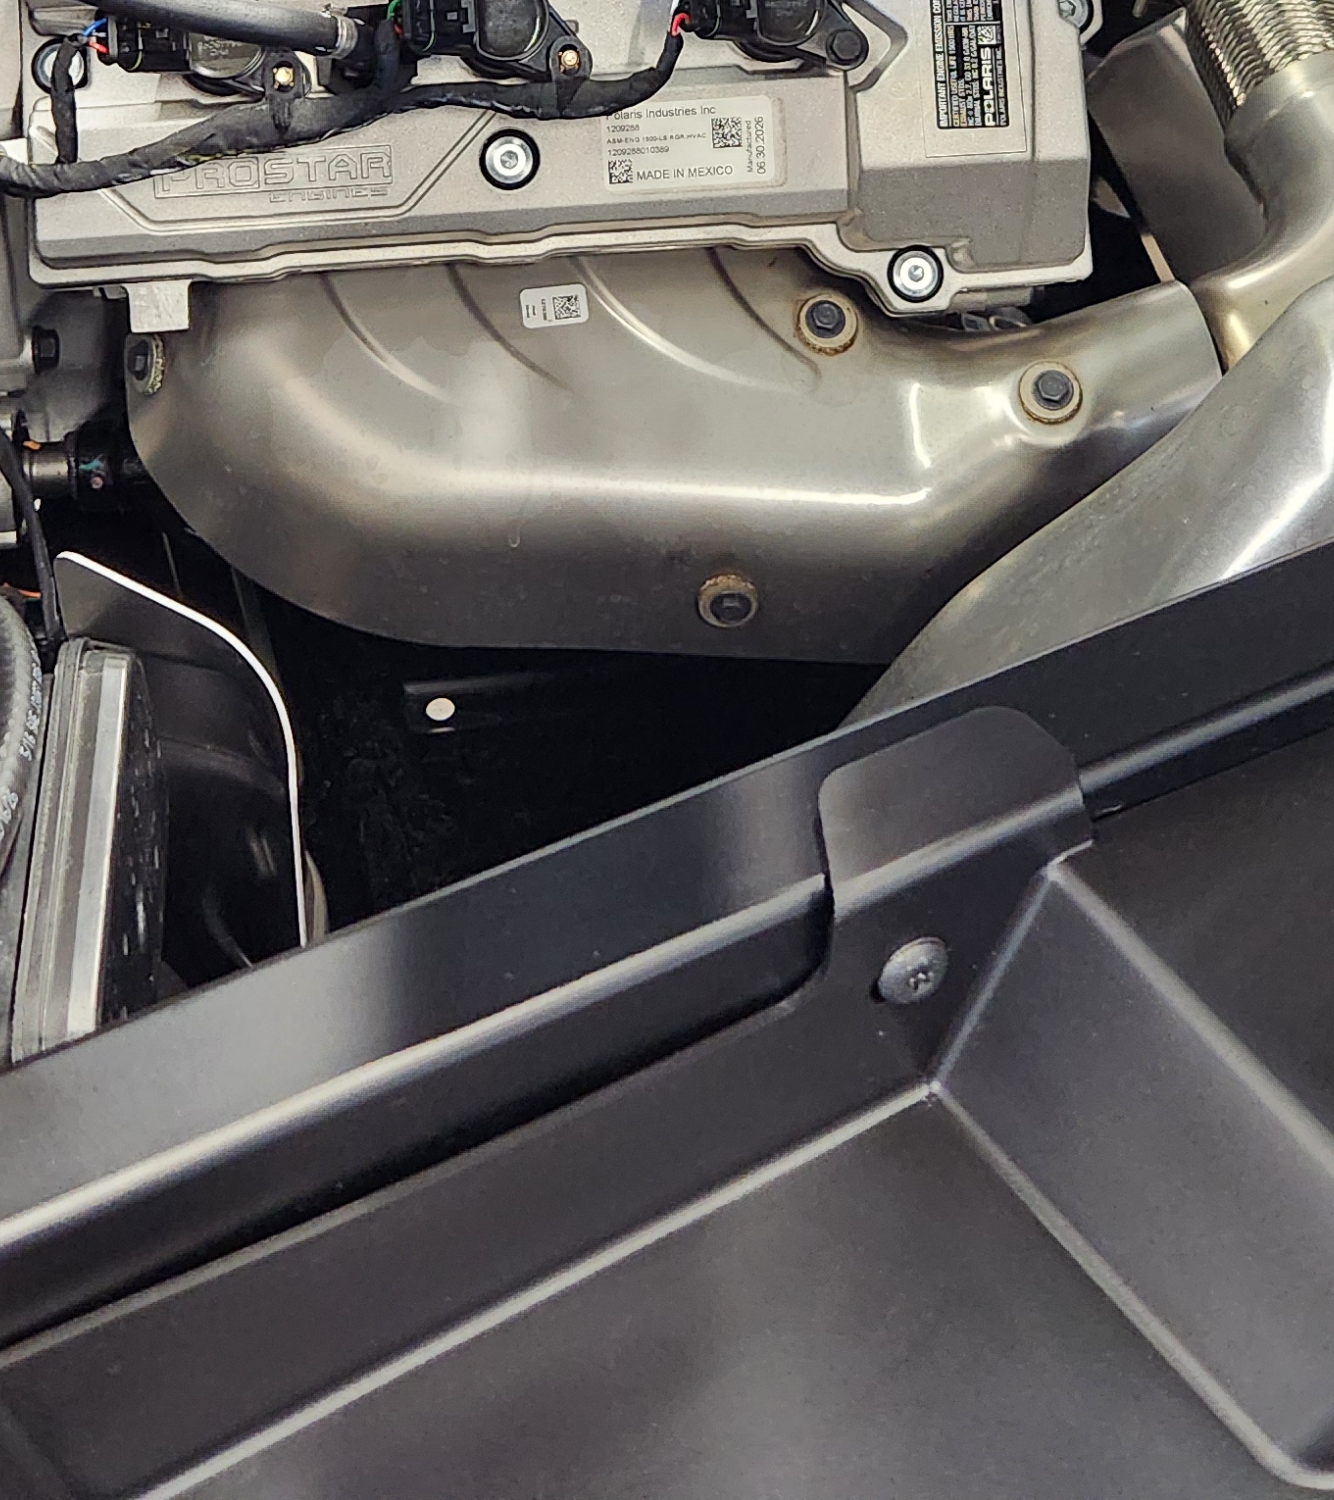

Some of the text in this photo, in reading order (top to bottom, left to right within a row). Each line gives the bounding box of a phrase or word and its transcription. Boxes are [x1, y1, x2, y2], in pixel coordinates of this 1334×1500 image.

[933, 15, 943, 51] EMISSION
[938, 83, 948, 126] IMPORTANT
[980, 47, 995, 125] POLARIS
[607, 105, 716, 120] olaris Industries Inc
[754, 116, 766, 174] 06.30.2026
[162, 152, 391, 193] PROSTAR
[637, 165, 733, 181] MADE IN MEXICO
[270, 187, 388, 203] ENGINES
